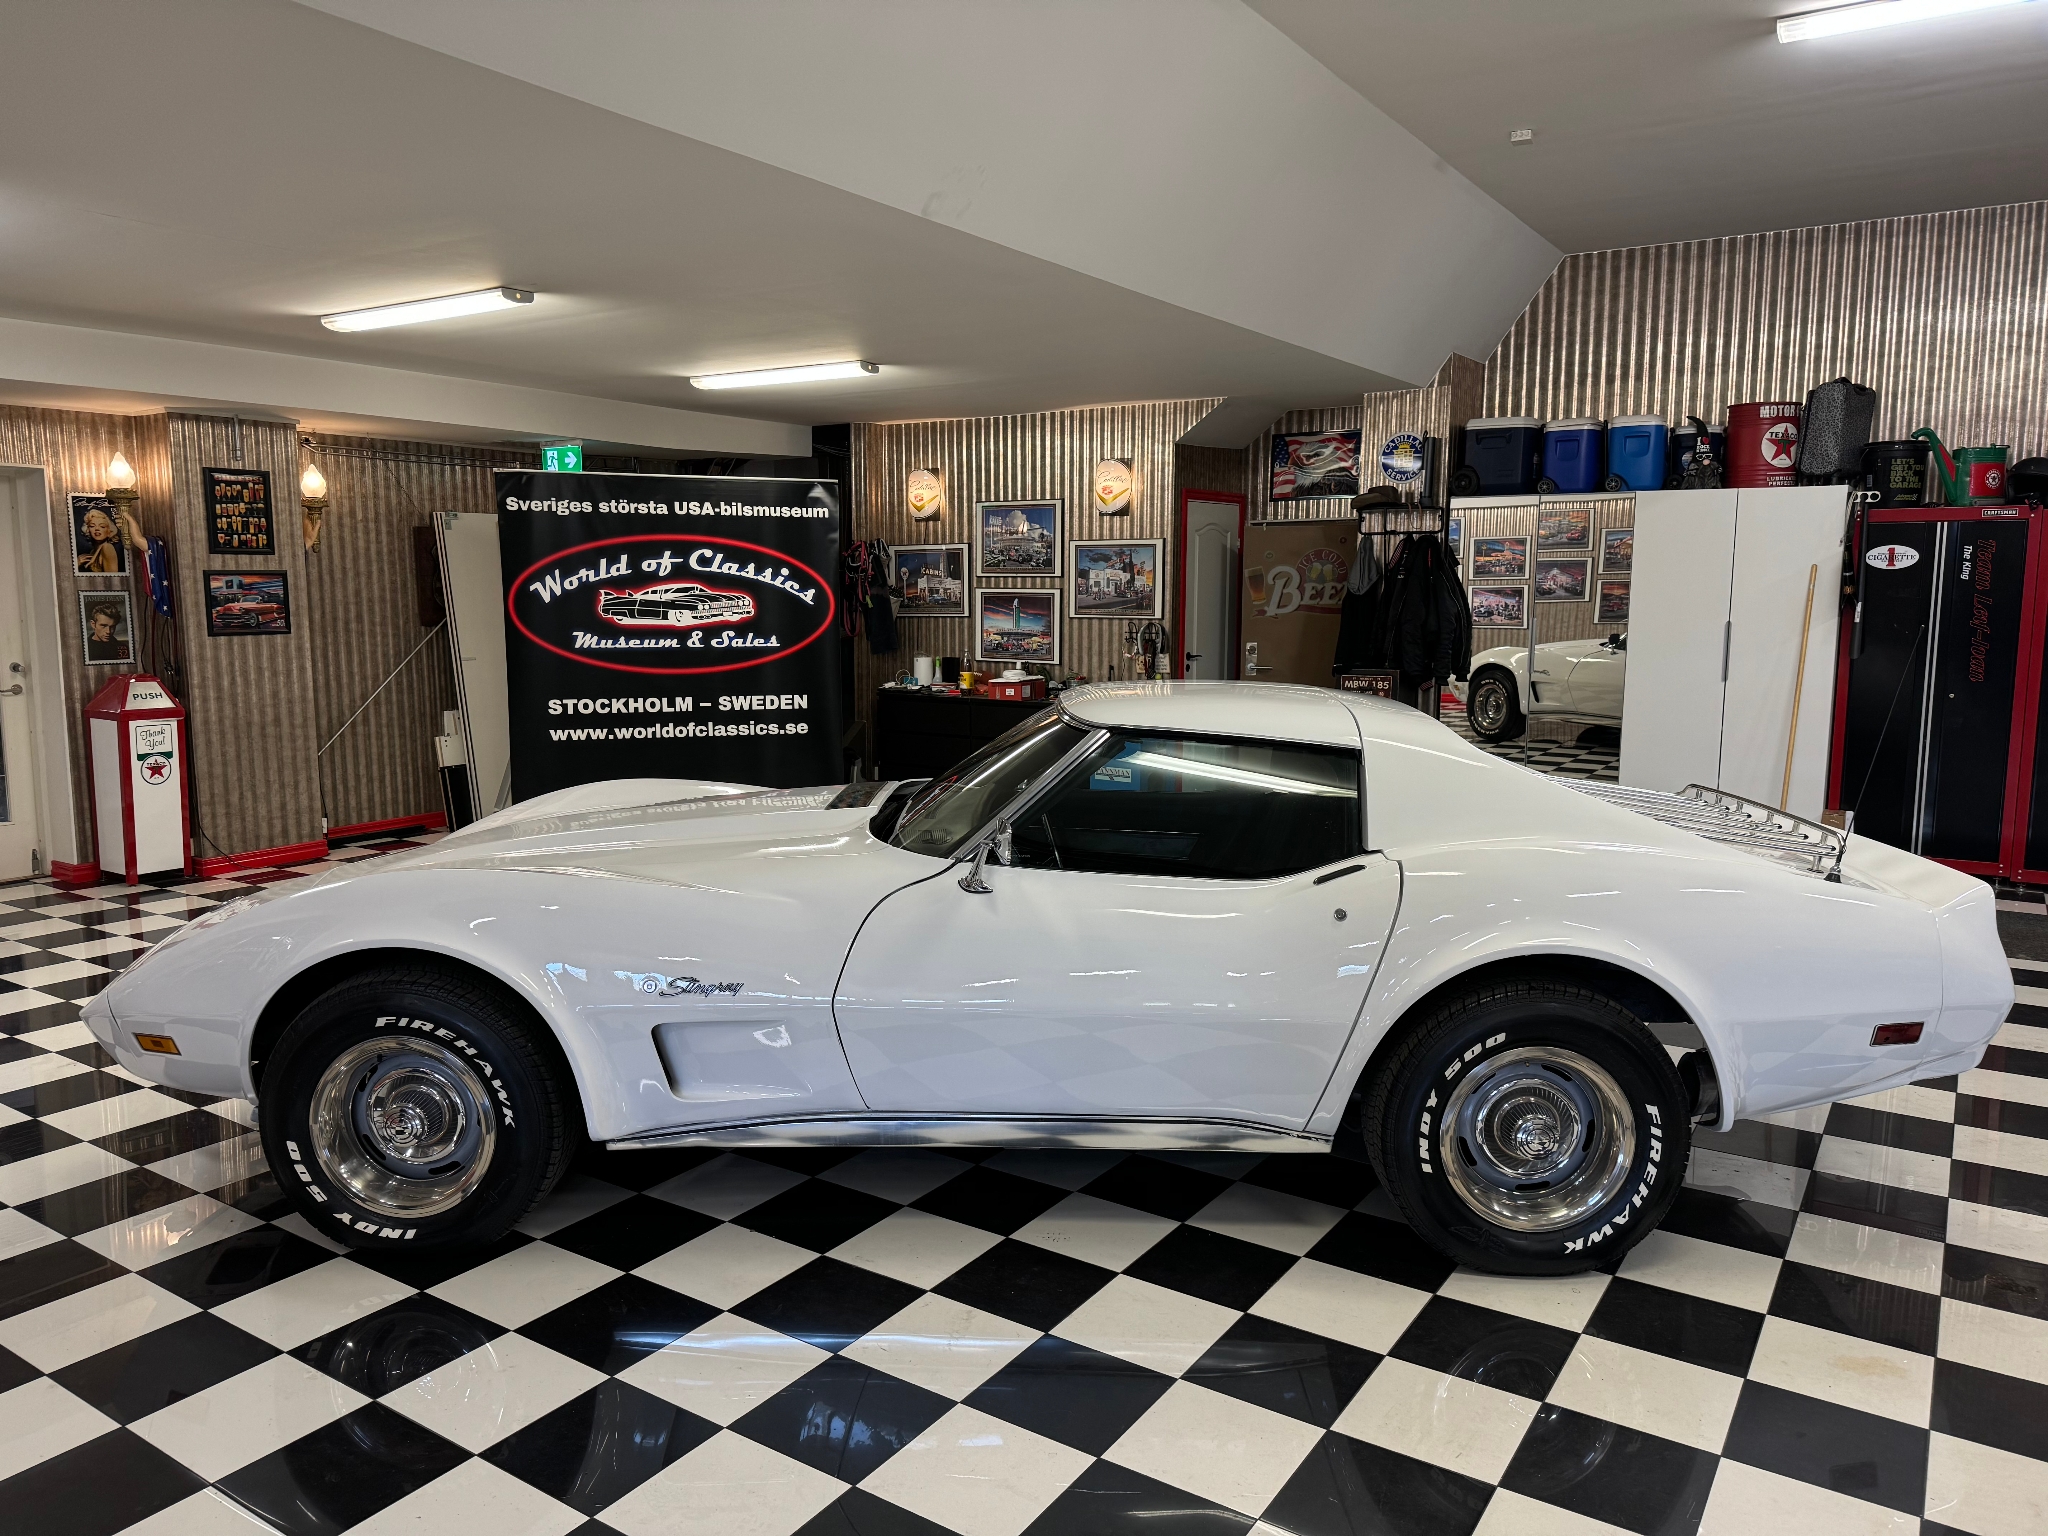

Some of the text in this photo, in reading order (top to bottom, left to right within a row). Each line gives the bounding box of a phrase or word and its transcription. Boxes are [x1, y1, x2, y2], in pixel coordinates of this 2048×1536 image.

[1760, 405, 1795, 418] MOTOR
[1384, 434, 1422, 453] CADILLAC
[1769, 431, 1798, 440] TEXACO
[1386, 468, 1420, 481] SERVICE
[505, 496, 829, 519] Sveriges största USA-bilsmuseum
[1298, 550, 1347, 574] ICE COLD
[1963, 545, 1973, 560] The
[529, 549, 816, 605] World of Classics
[1267, 565, 1348, 617] BEE
[572, 630, 781, 649] Museum & Sales
[1344, 680, 1390, 690] MBW 185
[132, 692, 163, 701] PUSH
[548, 696, 693, 715] STOCKHOLM
[718, 694, 808, 711] SWEDEN
[140, 726, 166, 741] Thank
[549, 720, 809, 741] www.worldofclassics.se
[145, 735, 166, 751] You!
[658, 976, 745, 998] Stingray
[374, 1016, 516, 1129] FIREHAWK
[1419, 1032, 1507, 1174] INDY 500
[1563, 1103, 1663, 1254] FIREHAWK
[285, 1140, 418, 1240] INDY 500
